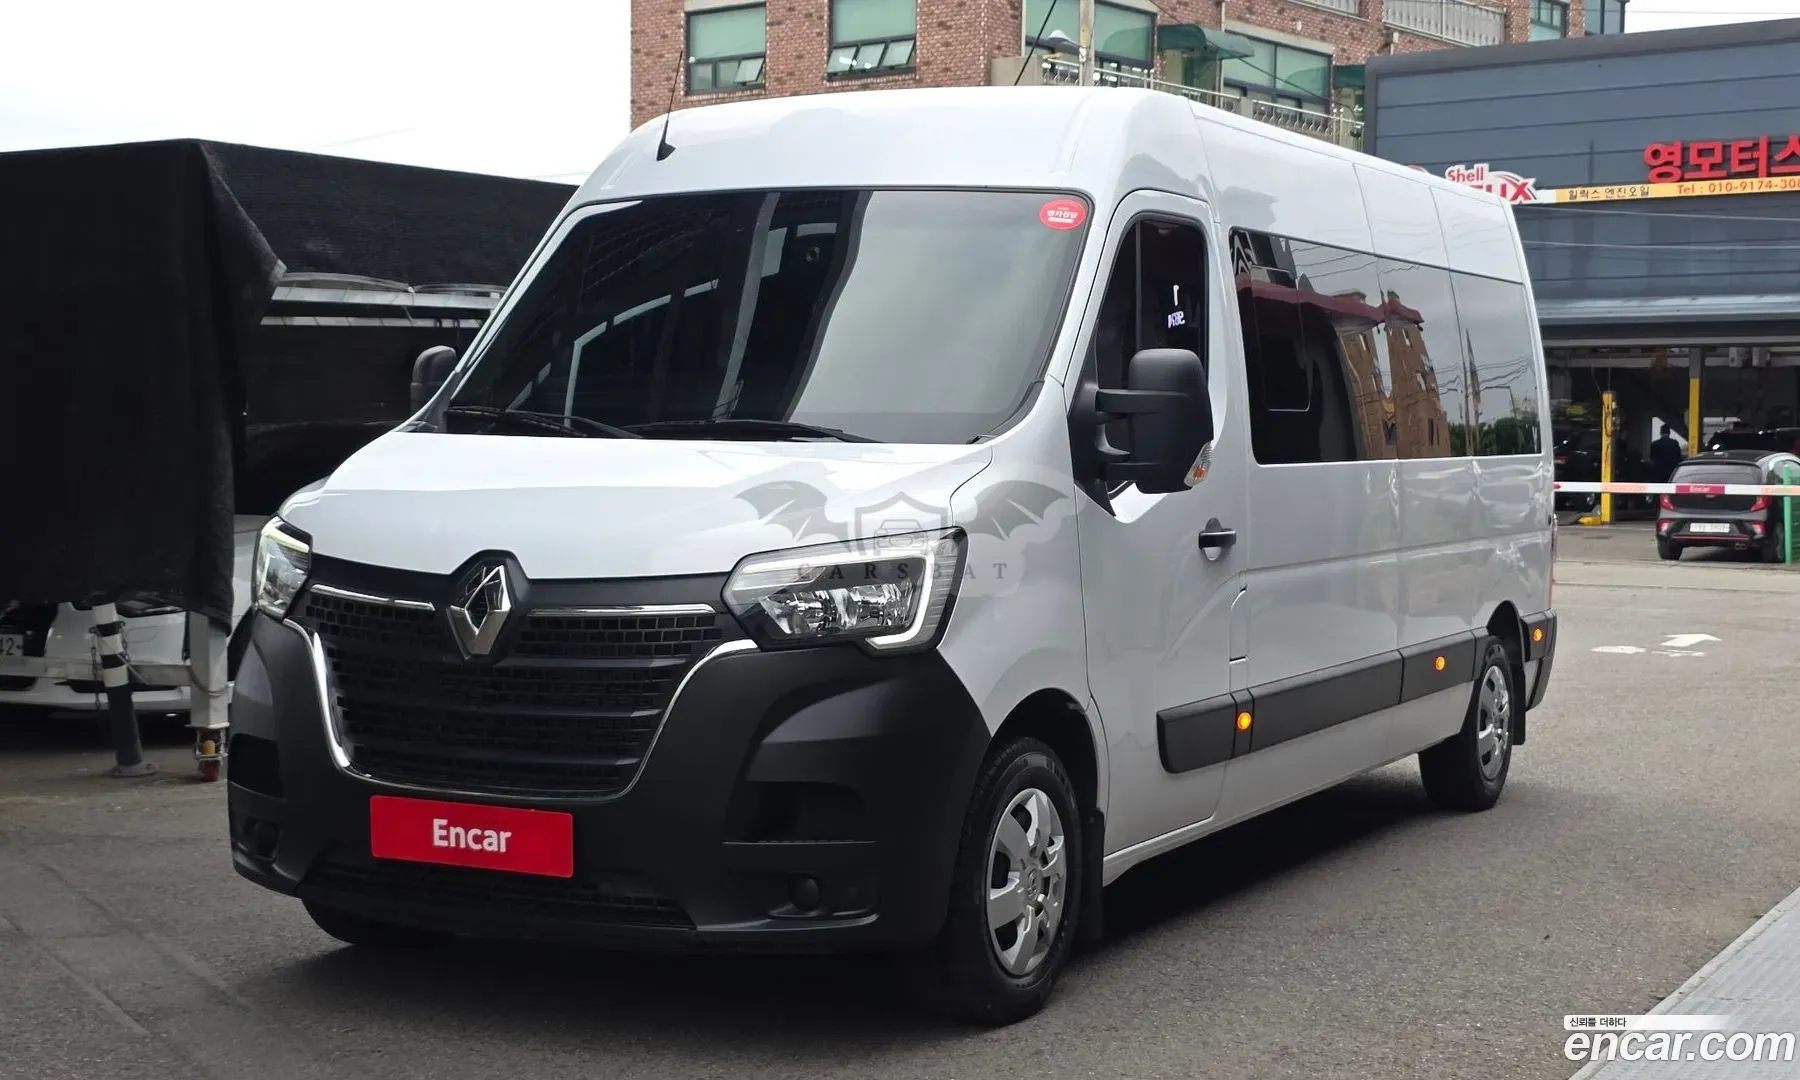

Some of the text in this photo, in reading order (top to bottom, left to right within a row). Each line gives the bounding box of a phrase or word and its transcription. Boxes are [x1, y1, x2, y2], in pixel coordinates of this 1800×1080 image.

[1643, 135, 1800, 184] 영모터스
[1447, 166, 1484, 182] Shell
[1604, 185, 1650, 199] 엔진오일
[1677, 183, 1695, 195] Tel
[432, 817, 513, 853] Encar
